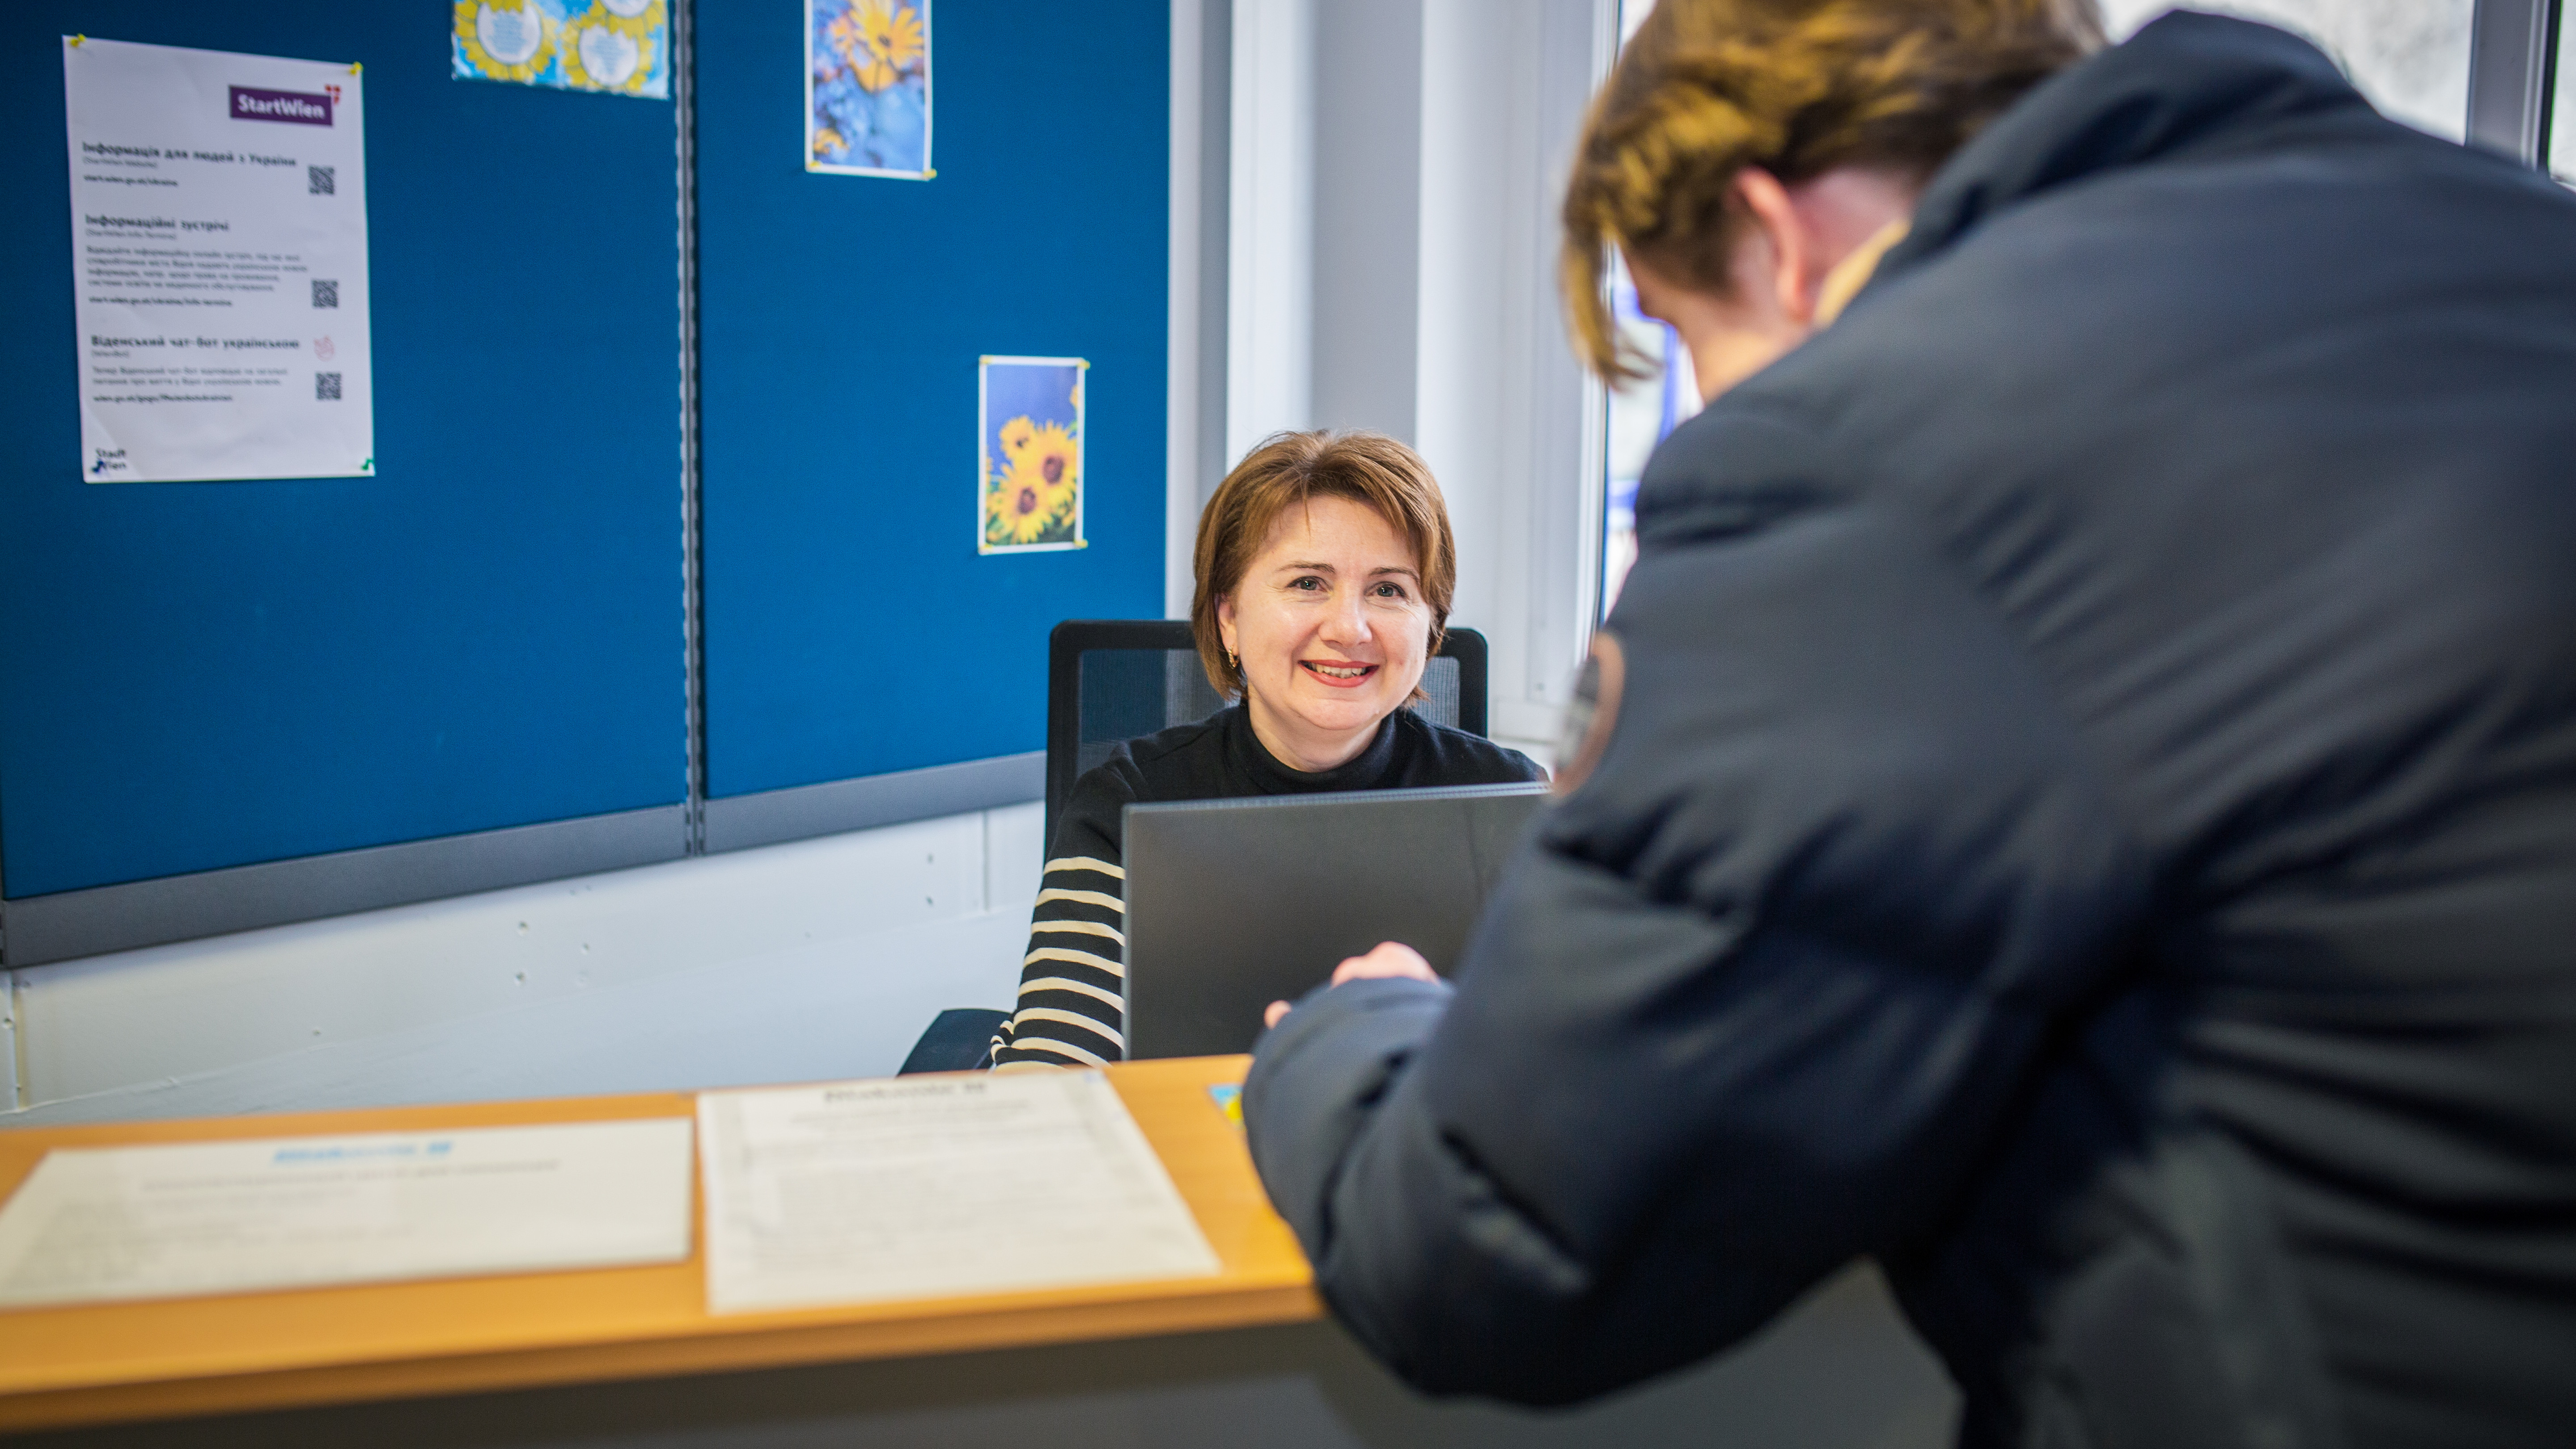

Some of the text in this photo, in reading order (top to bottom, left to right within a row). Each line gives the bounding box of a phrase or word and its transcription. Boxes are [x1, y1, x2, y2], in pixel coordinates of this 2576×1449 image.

[237, 93, 326, 119] StartWien
[82, 141, 159, 157] Інформація
[165, 149, 187, 160] для
[192, 151, 233, 163] людей
[248, 153, 296, 167] України
[91, 335, 165, 347] Віденський
[223, 337, 300, 350] українською
